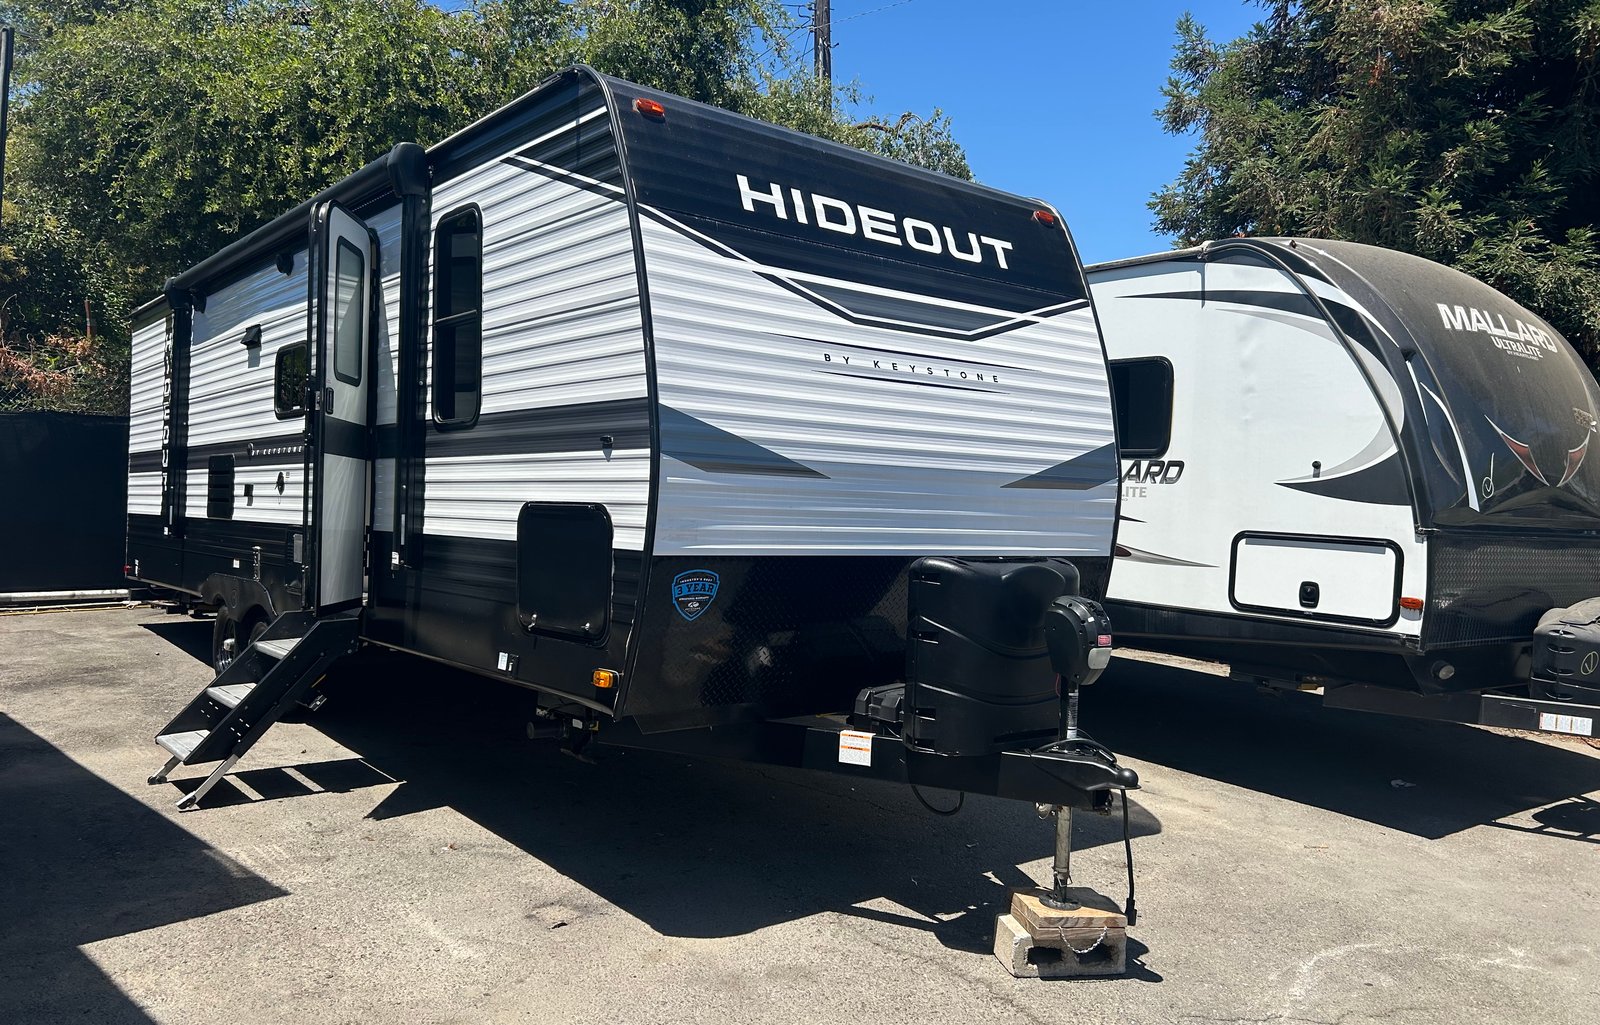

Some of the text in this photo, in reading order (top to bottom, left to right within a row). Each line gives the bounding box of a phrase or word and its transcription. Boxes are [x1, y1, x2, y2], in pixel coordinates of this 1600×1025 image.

[735, 174, 1013, 270] HIDEOUT
[1437, 303, 1558, 353] MALLARD
[824, 353, 1000, 383] BY KEYSTONE
[676, 583, 714, 595] 3 YEAR
